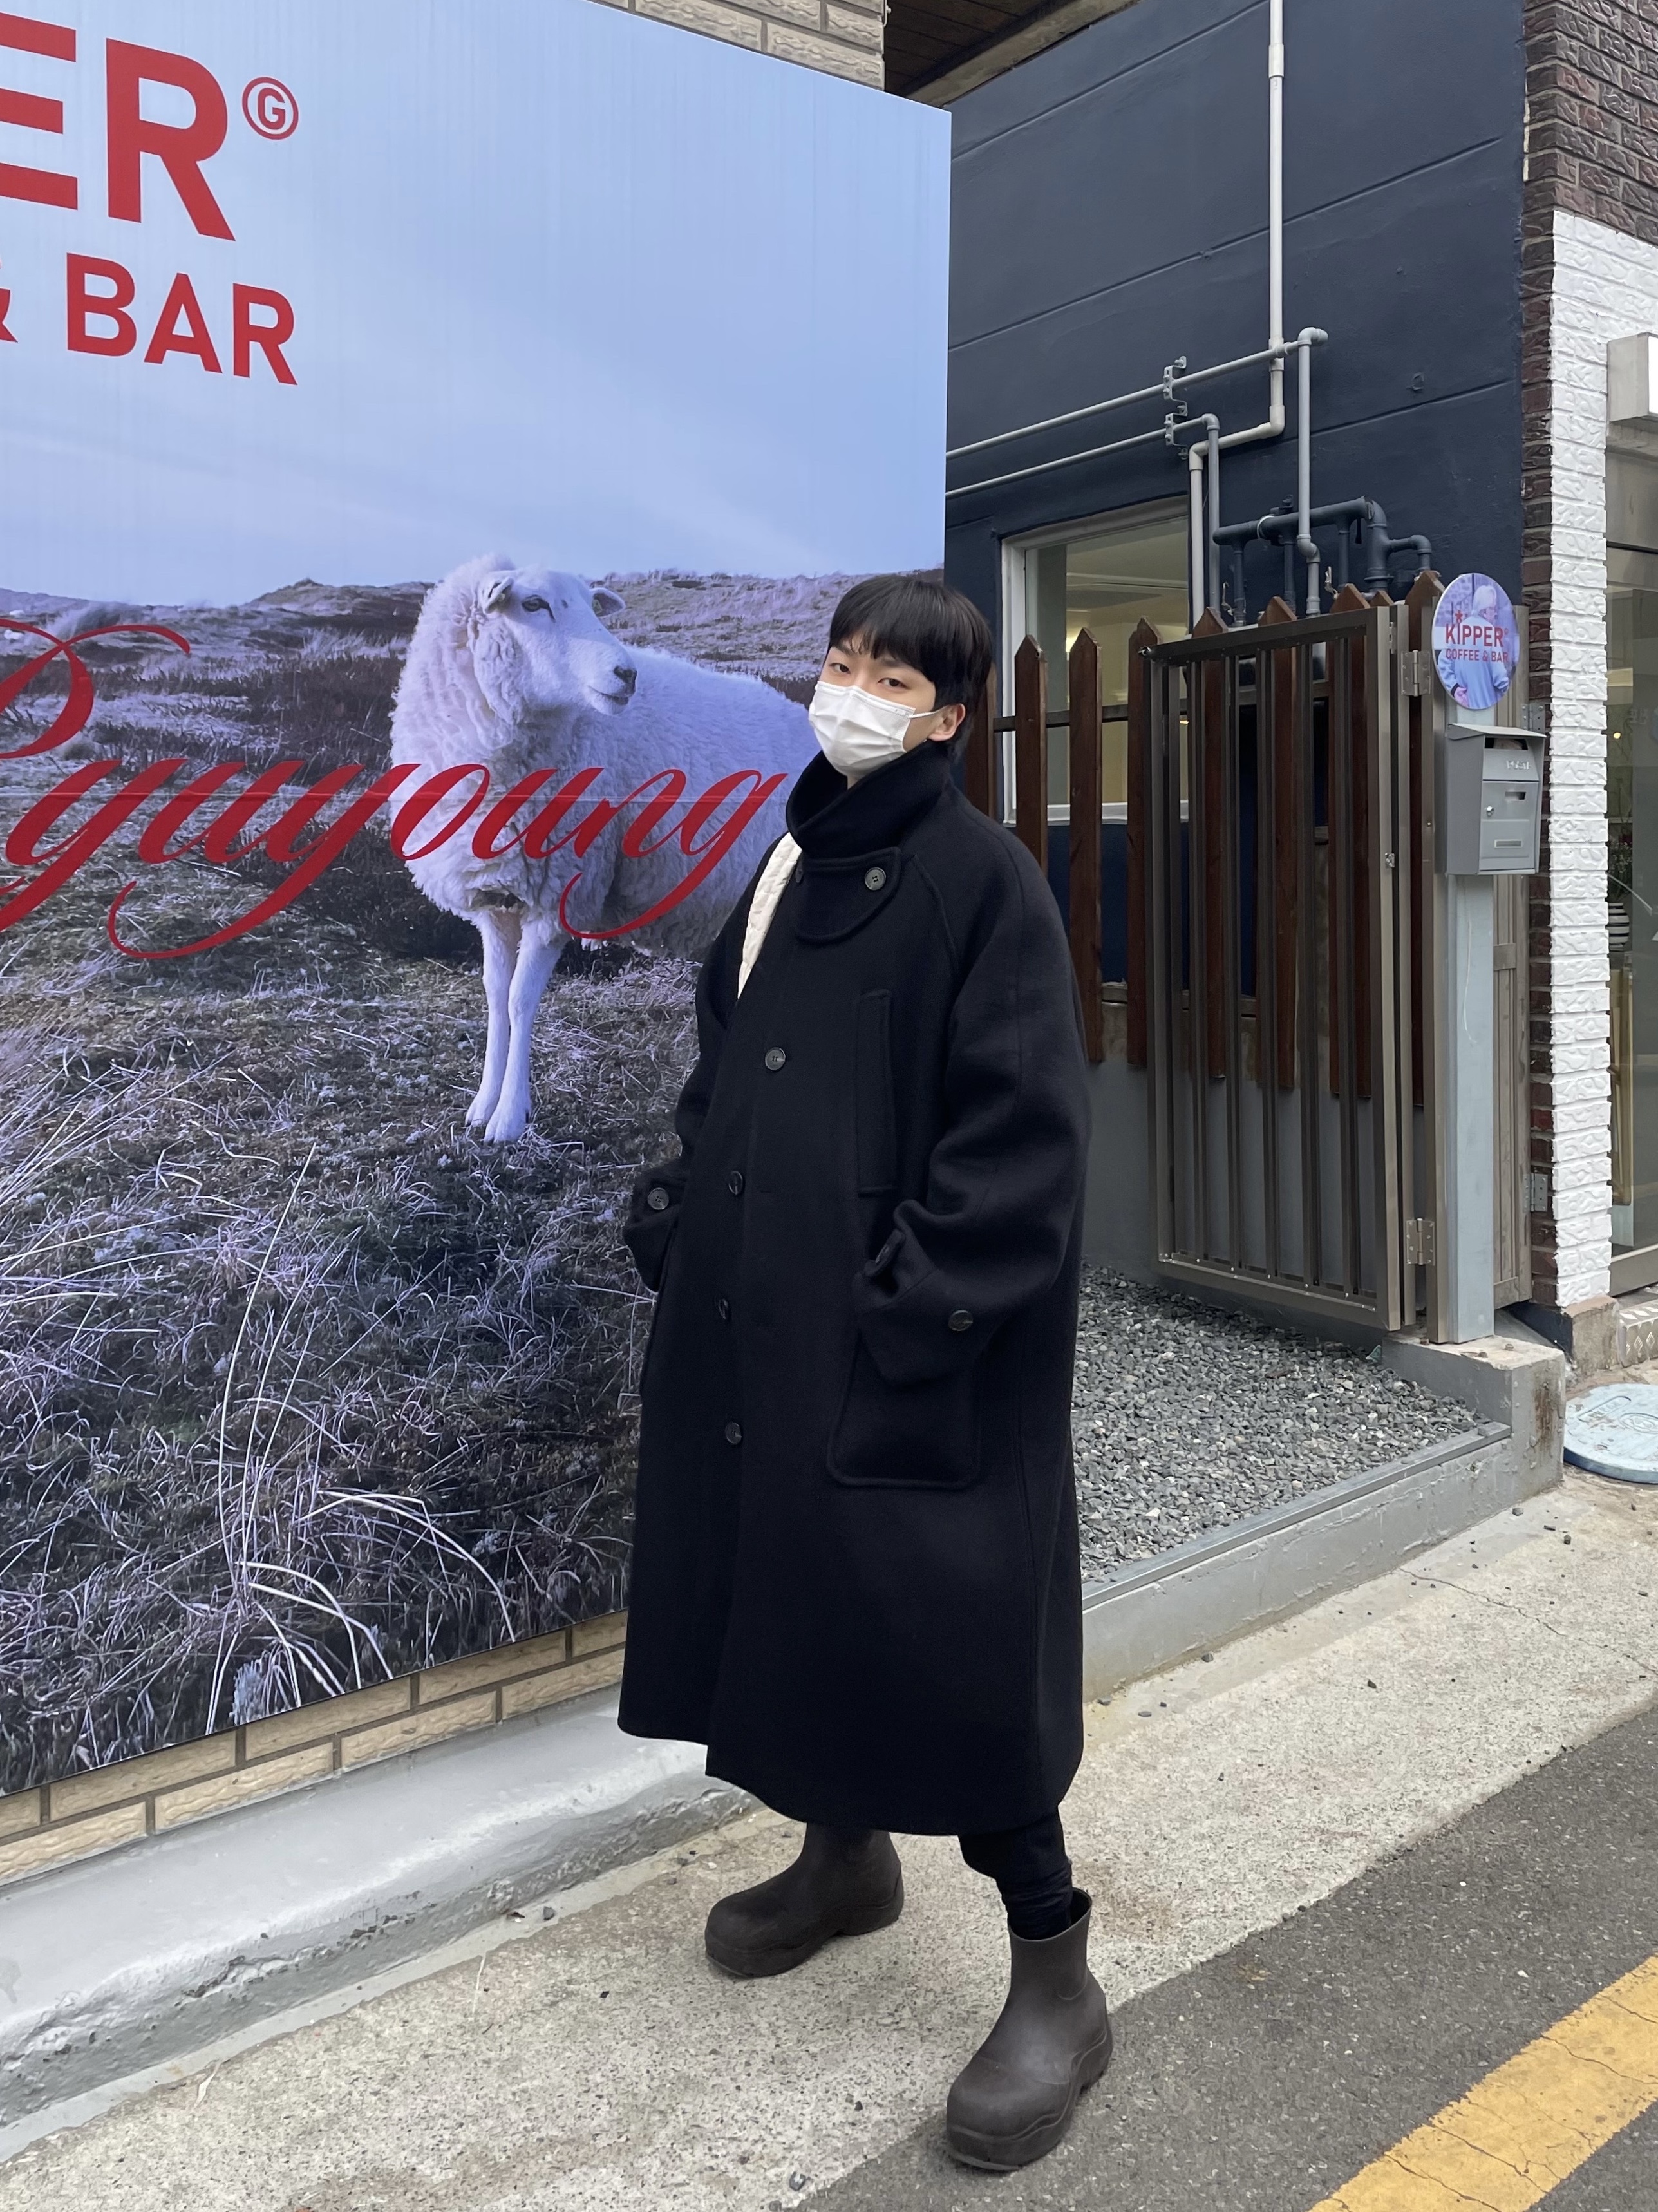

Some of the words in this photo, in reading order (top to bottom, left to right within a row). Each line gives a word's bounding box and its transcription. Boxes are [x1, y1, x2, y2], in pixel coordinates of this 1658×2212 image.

[67, 252, 297, 385] BAR
[1446, 623, 1504, 647] KIPPER
[1446, 648, 1480, 661] COFFEE
[1482, 650, 1488, 662] &
[1491, 651, 1508, 663] BAR
